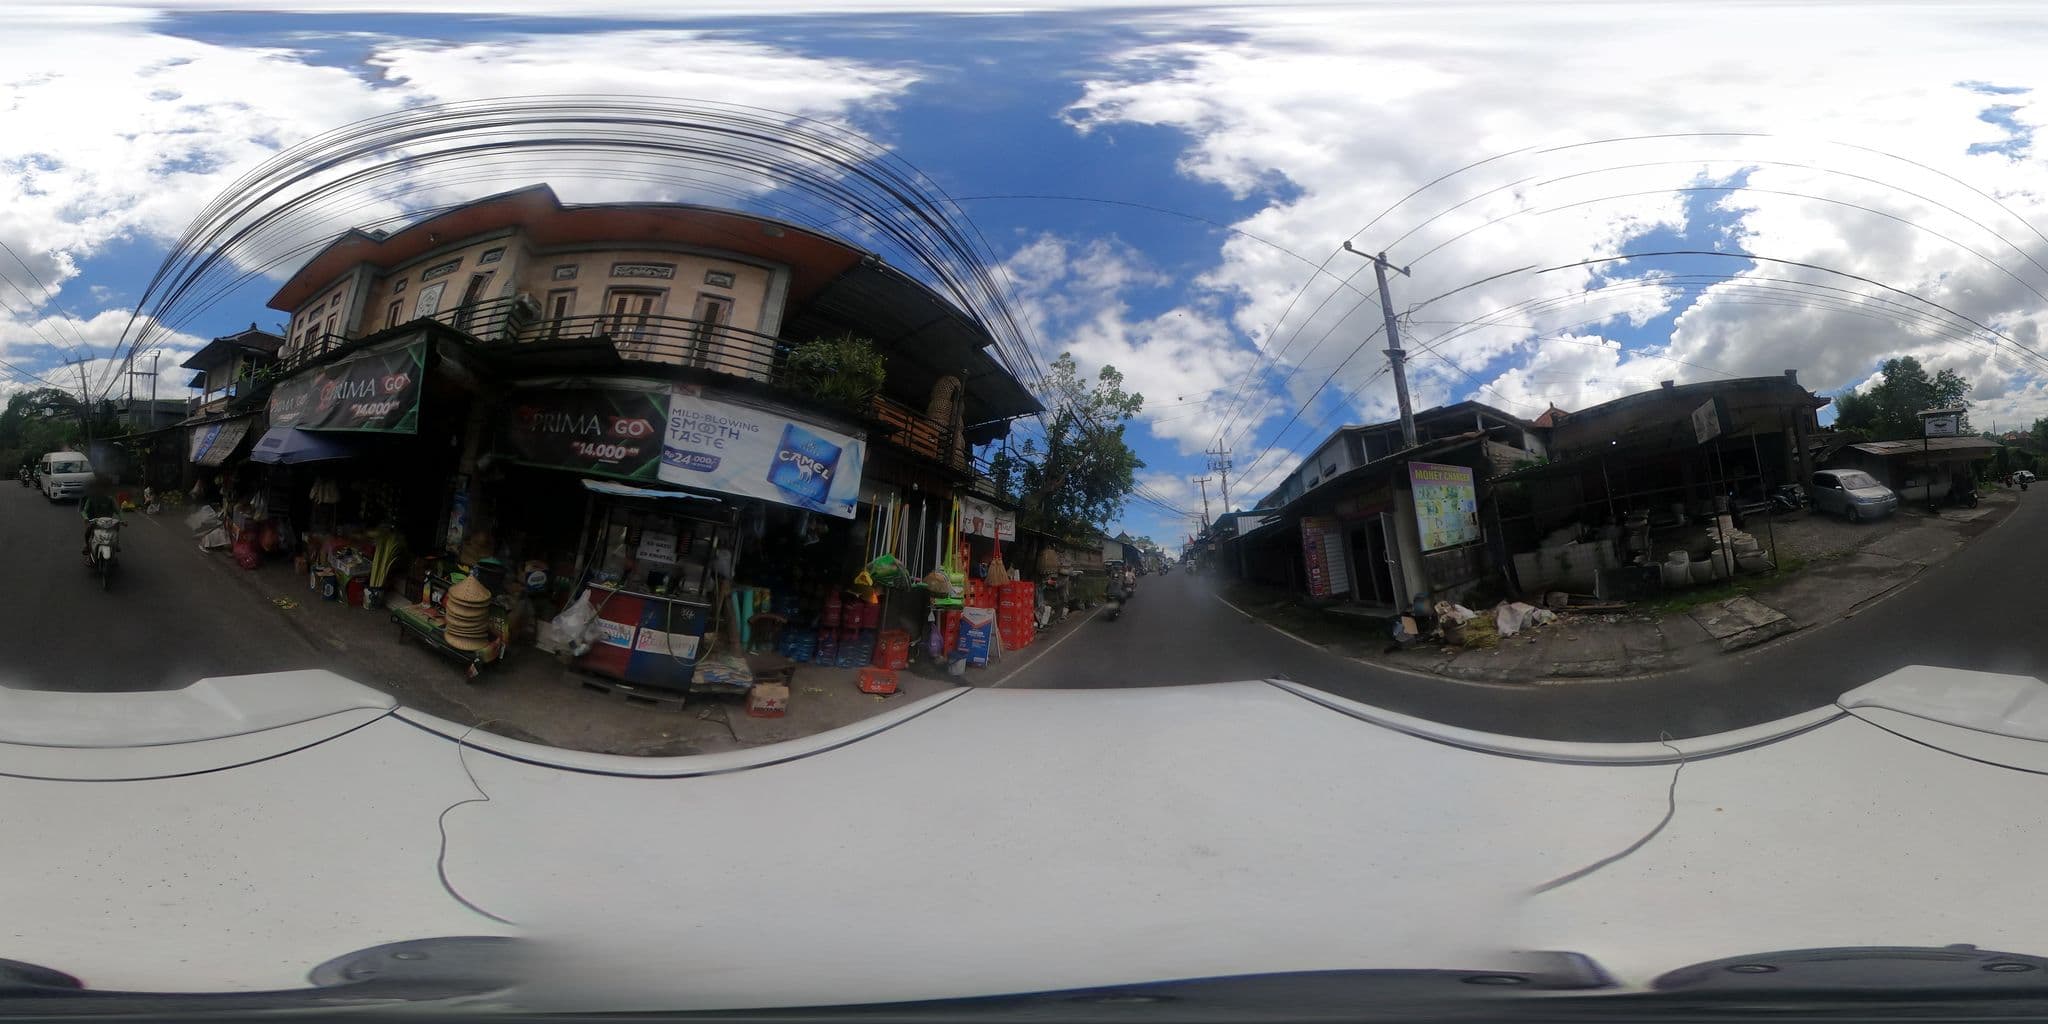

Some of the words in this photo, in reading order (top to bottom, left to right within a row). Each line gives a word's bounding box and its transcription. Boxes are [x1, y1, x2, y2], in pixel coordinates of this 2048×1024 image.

[384, 375, 404, 391] GO
[529, 412, 601, 436] PRIMA
[615, 419, 645, 436] GO
[671, 417, 740, 440] SMOOTH
[672, 408, 760, 432] MILD-BLOWING
[670, 428, 724, 449] TASTE
[779, 450, 829, 480] CAMEL
[1414, 470, 1442, 480] MONEY
